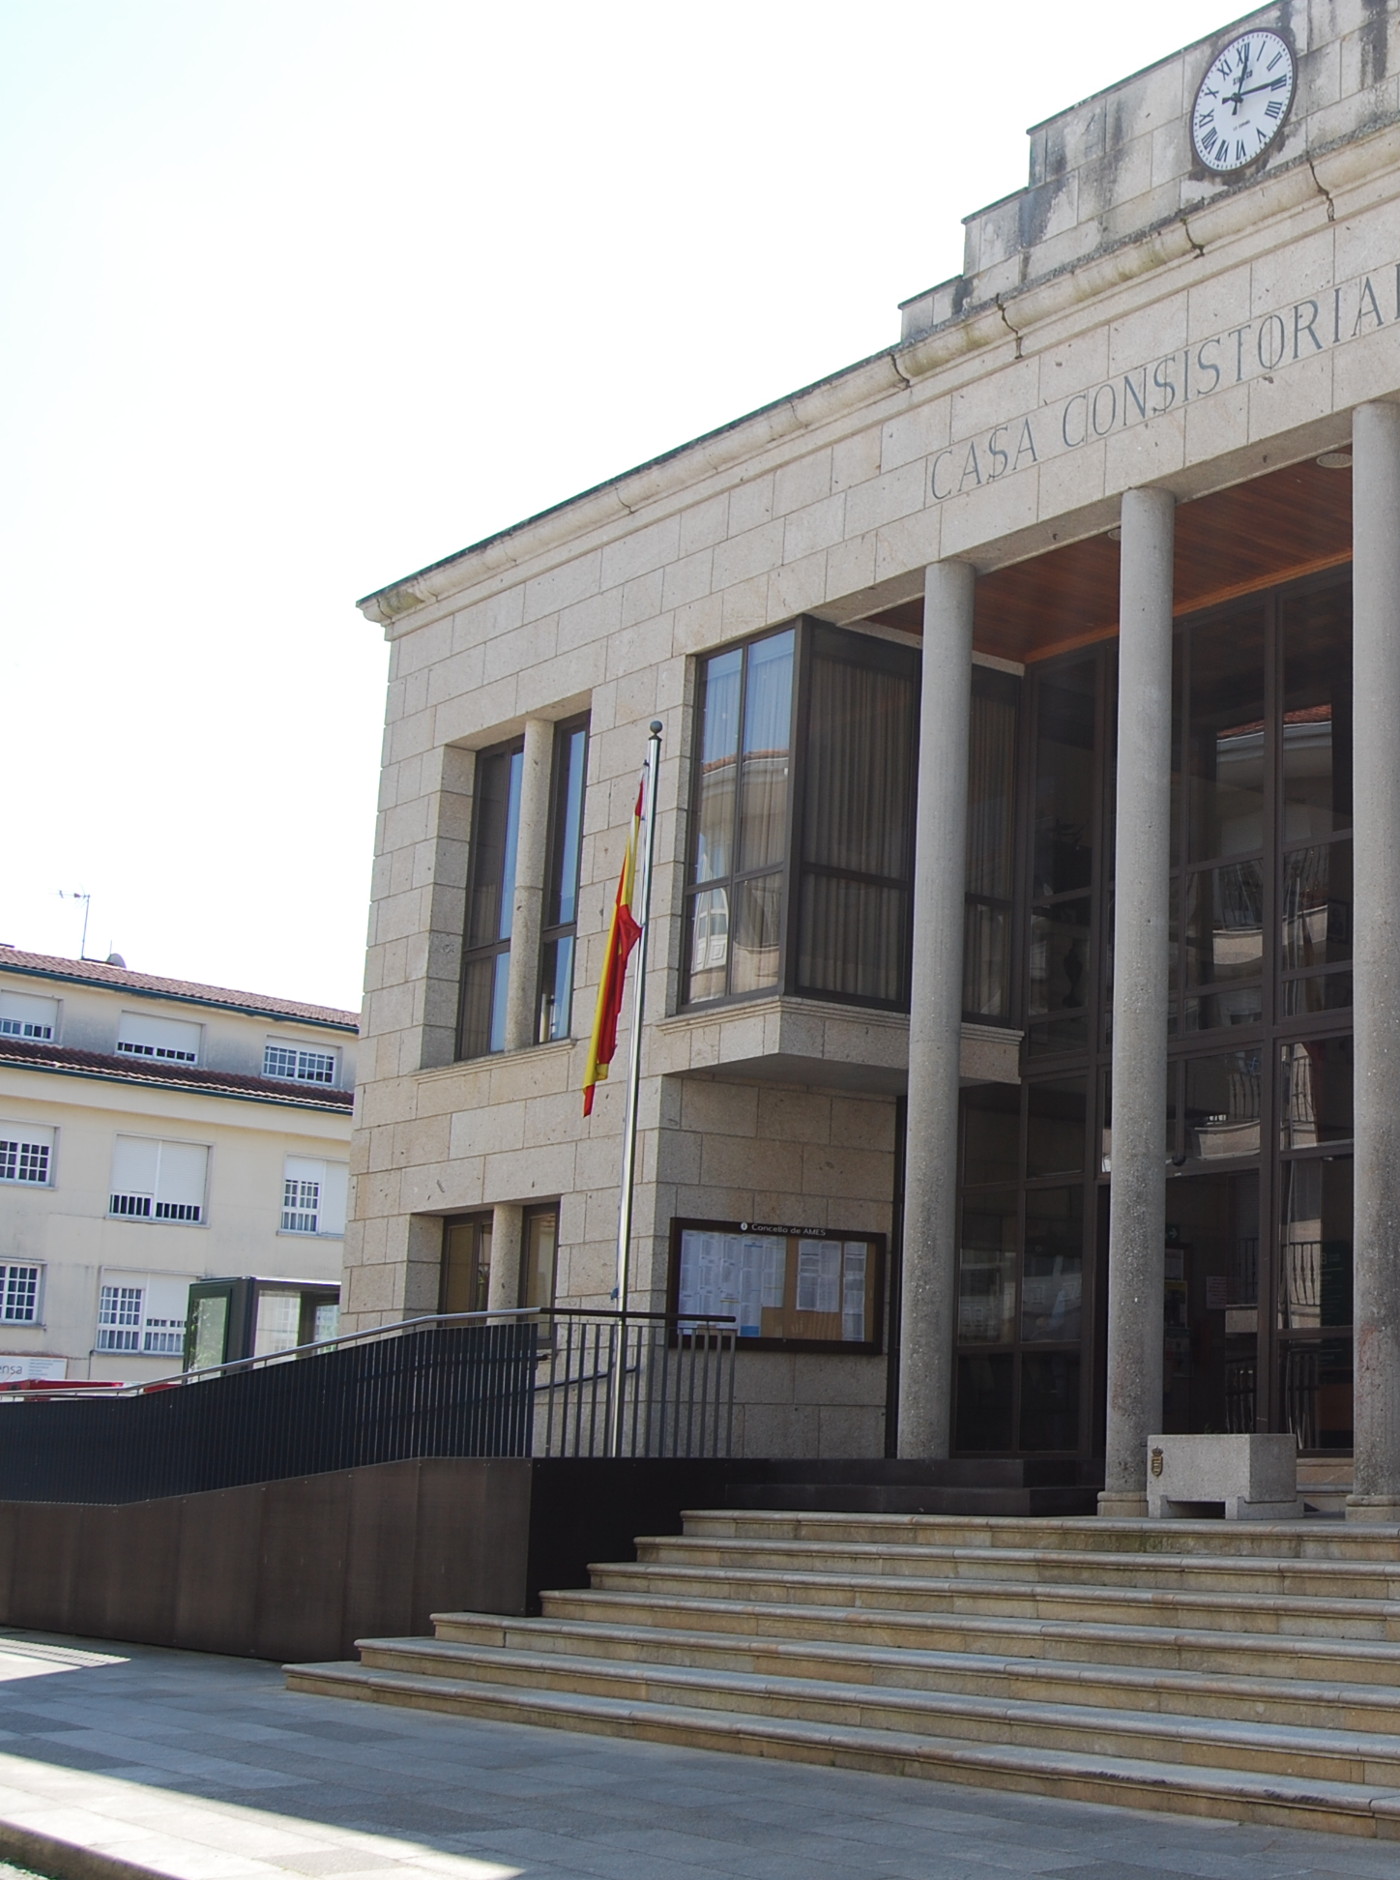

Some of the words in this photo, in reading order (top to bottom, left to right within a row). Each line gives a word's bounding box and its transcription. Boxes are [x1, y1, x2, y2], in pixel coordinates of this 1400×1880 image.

[1217, 59, 1231, 81] XI
[1267, 51, 1282, 71] II
[1204, 87, 1219, 98] X
[1199, 108, 1215, 128] IX
[1256, 127, 1267, 144] V
[1235, 139, 1246, 161] VI
[931, 417, 1038, 500] CASA
[751, 1223, 788, 1234] Concello
[790, 1226, 801, 1235] de
[803, 1227, 827, 1237] AMES
